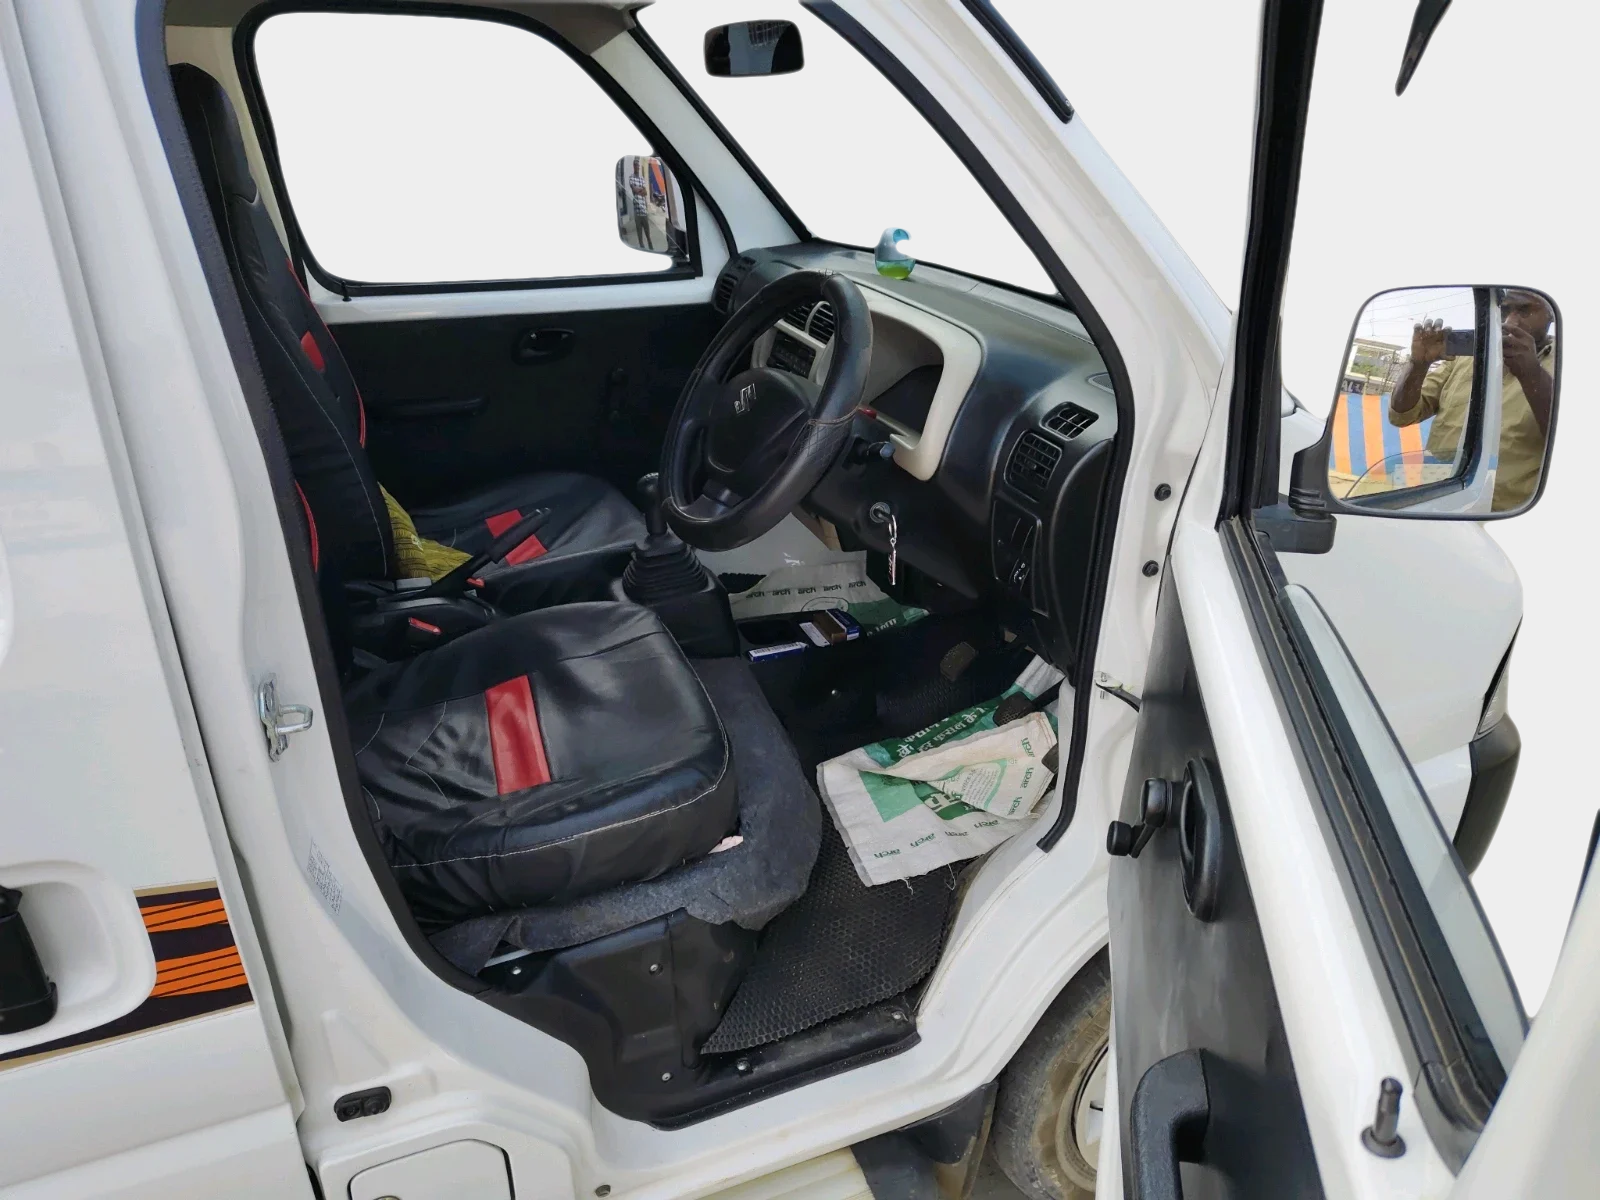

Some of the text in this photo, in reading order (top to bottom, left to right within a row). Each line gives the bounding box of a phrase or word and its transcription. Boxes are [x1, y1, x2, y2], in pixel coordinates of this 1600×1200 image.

[772, 588, 791, 596] arch
[797, 586, 816, 595] arch
[823, 583, 842, 592] arch
[848, 580, 866, 588] arch
[1007, 796, 1023, 816] arch
[1020, 767, 1035, 788] arch
[910, 833, 936, 848] arch
[874, 848, 902, 858] arch
